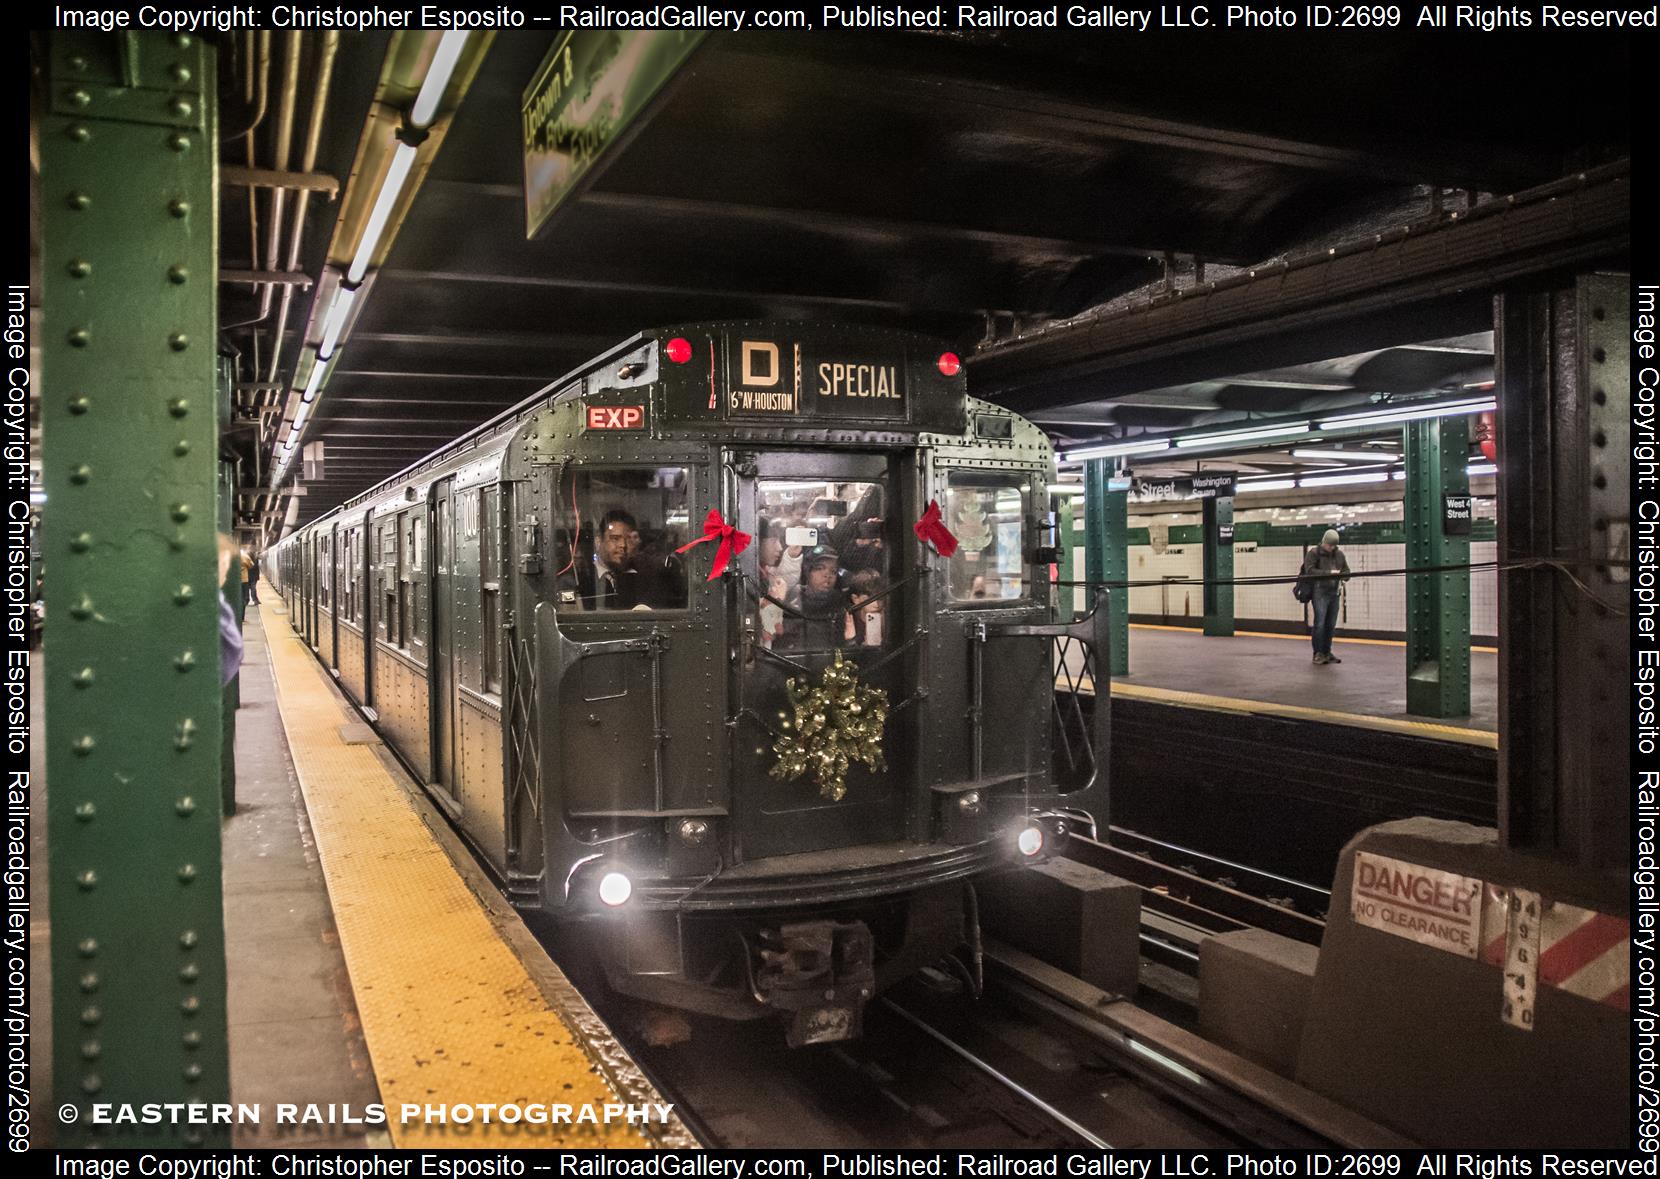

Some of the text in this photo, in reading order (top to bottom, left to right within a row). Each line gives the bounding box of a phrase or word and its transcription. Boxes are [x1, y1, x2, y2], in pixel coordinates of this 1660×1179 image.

[742, 341, 779, 386] D
[818, 362, 901, 399] SPECIAL
[590, 408, 641, 429] EXP
[1139, 481, 1176, 497] Street
[1192, 476, 1232, 488] Washington
[1192, 488, 1217, 497] Square
[1446, 499, 1471, 508] West 4
[1447, 509, 1469, 519] Street
[1358, 861, 1472, 916] DANGER
[1356, 901, 1471, 947] NO CLEARANCE
